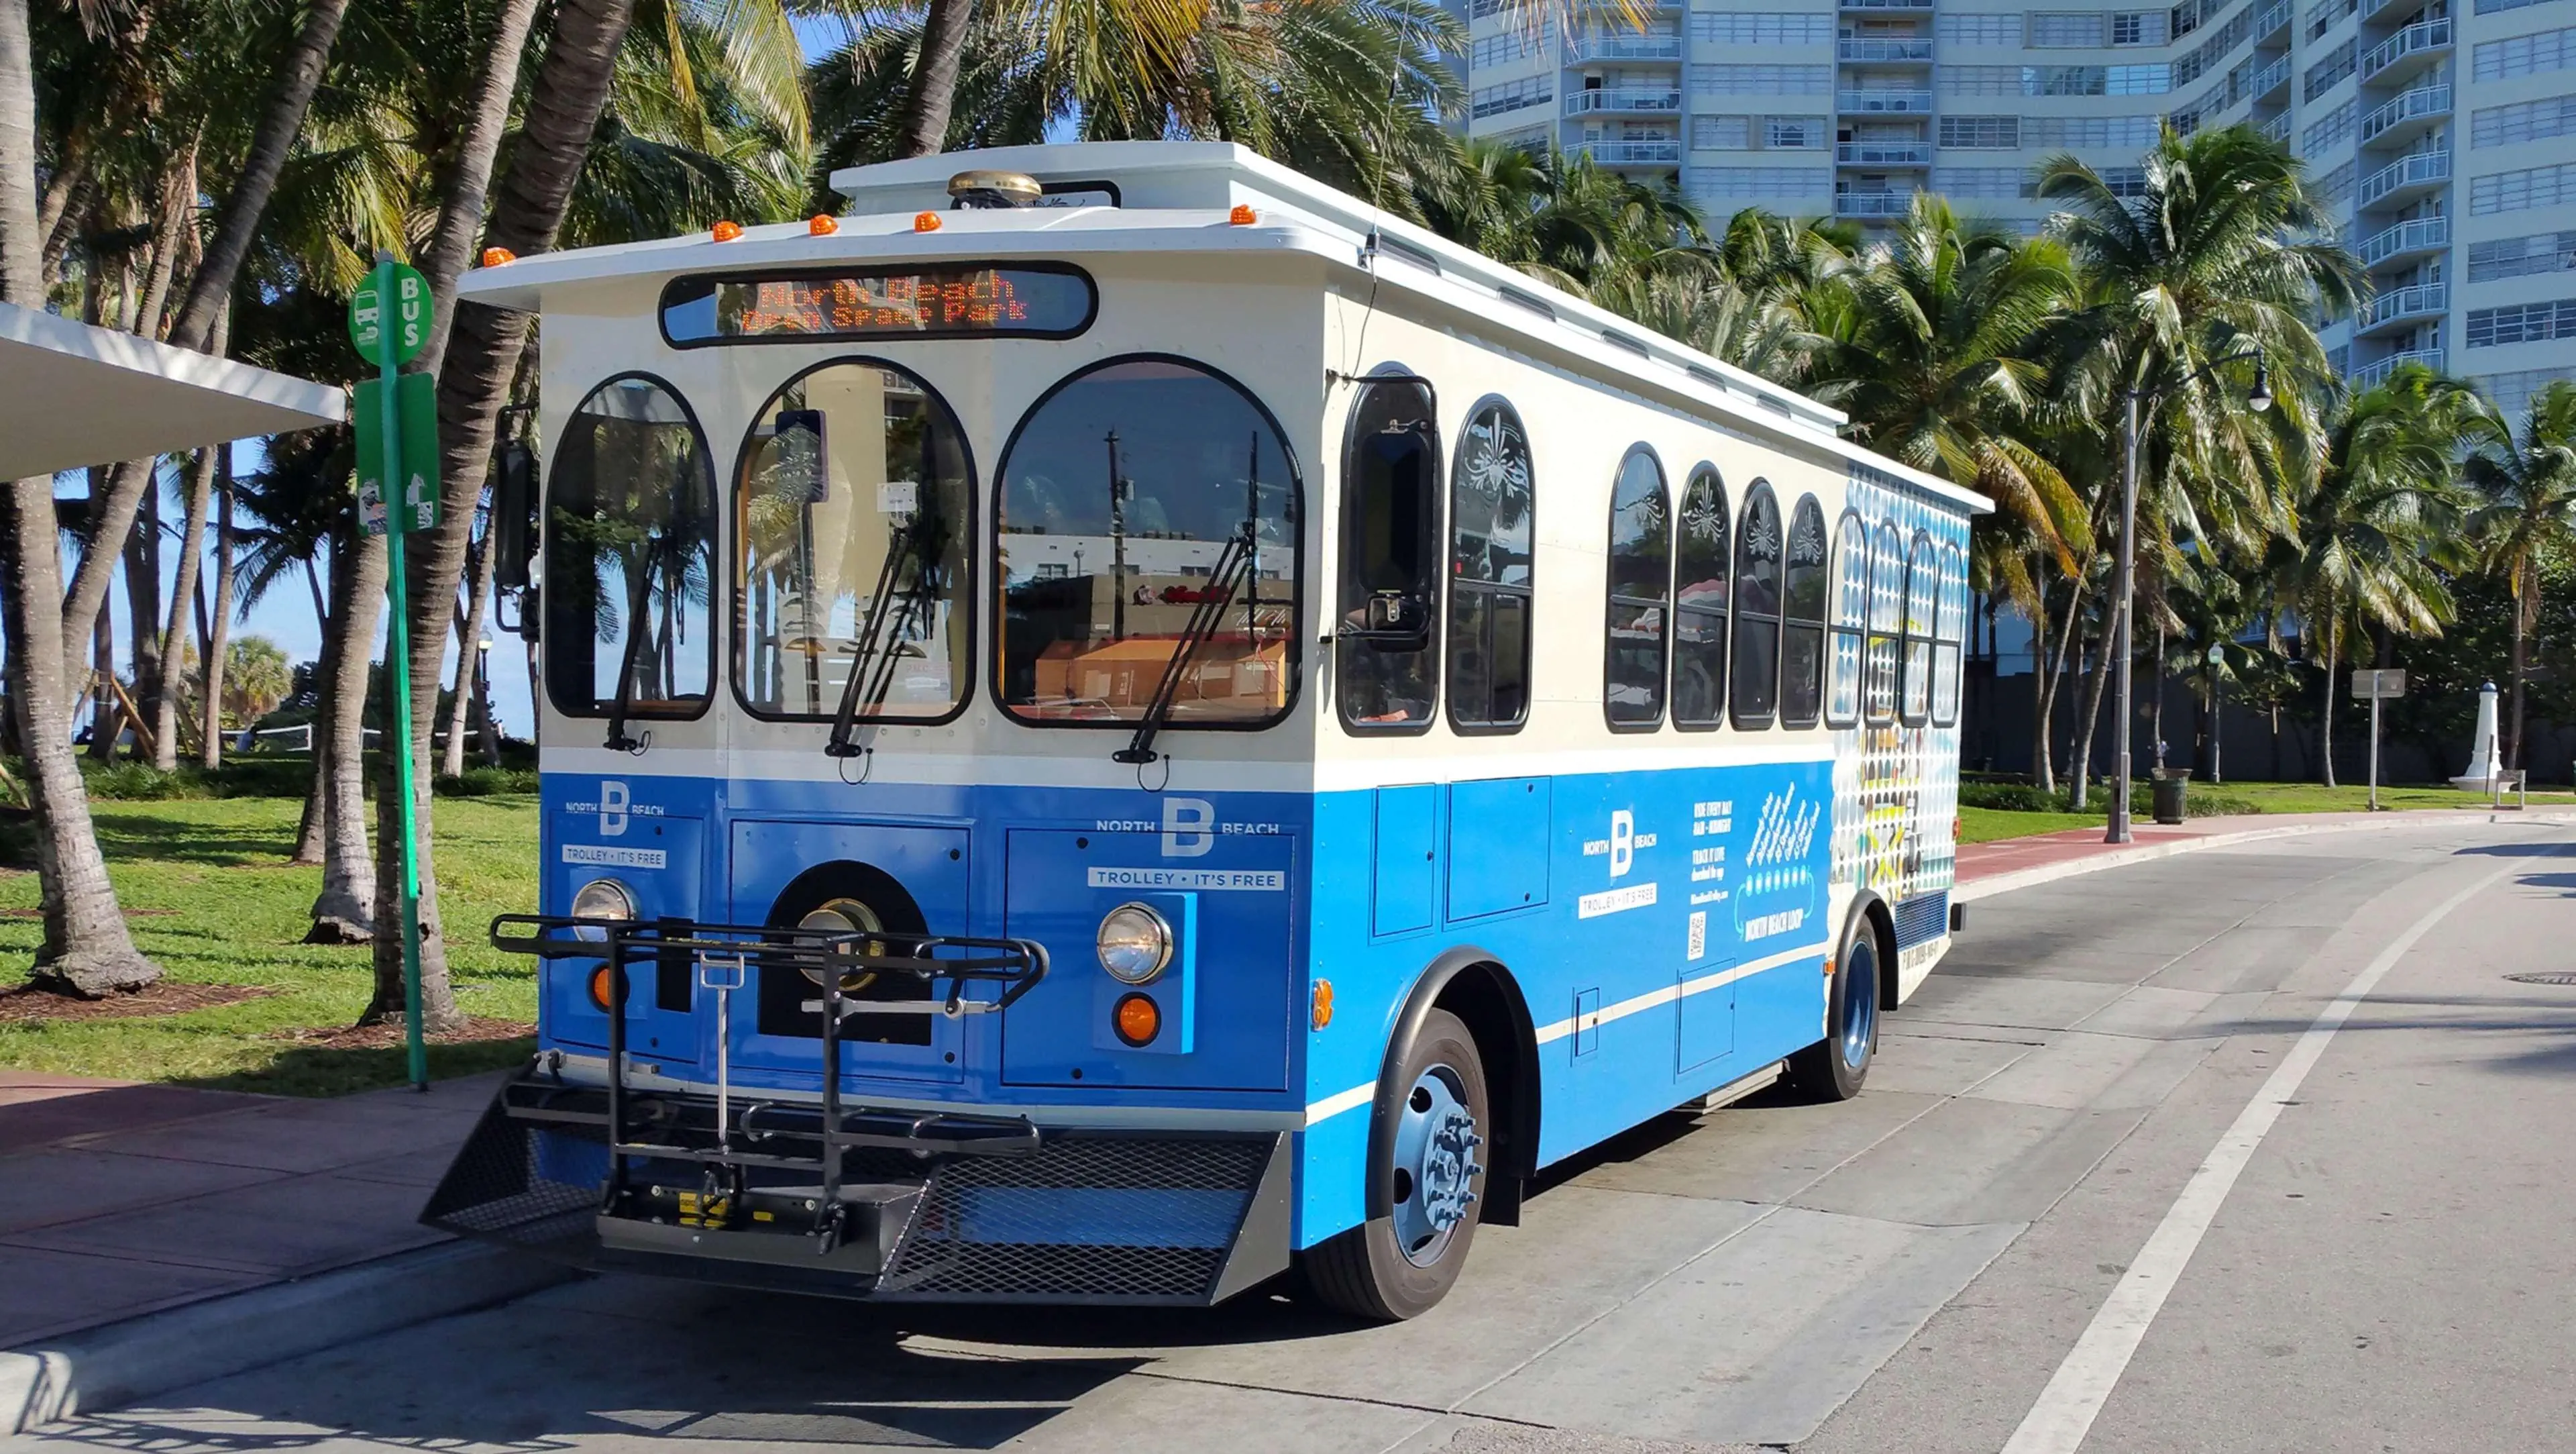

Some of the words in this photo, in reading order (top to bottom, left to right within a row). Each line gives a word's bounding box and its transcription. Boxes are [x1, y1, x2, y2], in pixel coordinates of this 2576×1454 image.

[761, 280, 871, 308] North
[887, 273, 1015, 302] Beach
[400, 277, 420, 348] BUS
[742, 309, 822, 331] Open
[832, 305, 934, 328] Space
[943, 299, 1028, 323] Park
[566, 802, 598, 814] NORTH
[599, 780, 631, 836] B
[631, 804, 665, 817] BEACH
[1096, 819, 1155, 832] NORTH
[1161, 796, 1216, 858] B
[1222, 823, 1280, 835] BEACH
[1582, 839, 1609, 857] NORTH
[1610, 809, 1634, 878] B
[1634, 833, 1657, 849] BEACH
[567, 848, 608, 862] TROLLEY
[616, 851, 635, 864] IT'S
[637, 853, 662, 865] FREE
[1097, 871, 1175, 885] TROLLEY
[1194, 874, 1226, 886] IT'S
[1232, 874, 1277, 887] FREE
[1583, 895, 1616, 913] TROLLEY
[1621, 891, 1635, 904] IT'S
[1637, 888, 1654, 901] FREE
[1746, 916, 1768, 941] NORTH
[1768, 912, 1787, 935] BEACH
[1787, 908, 1804, 930] LOOP
